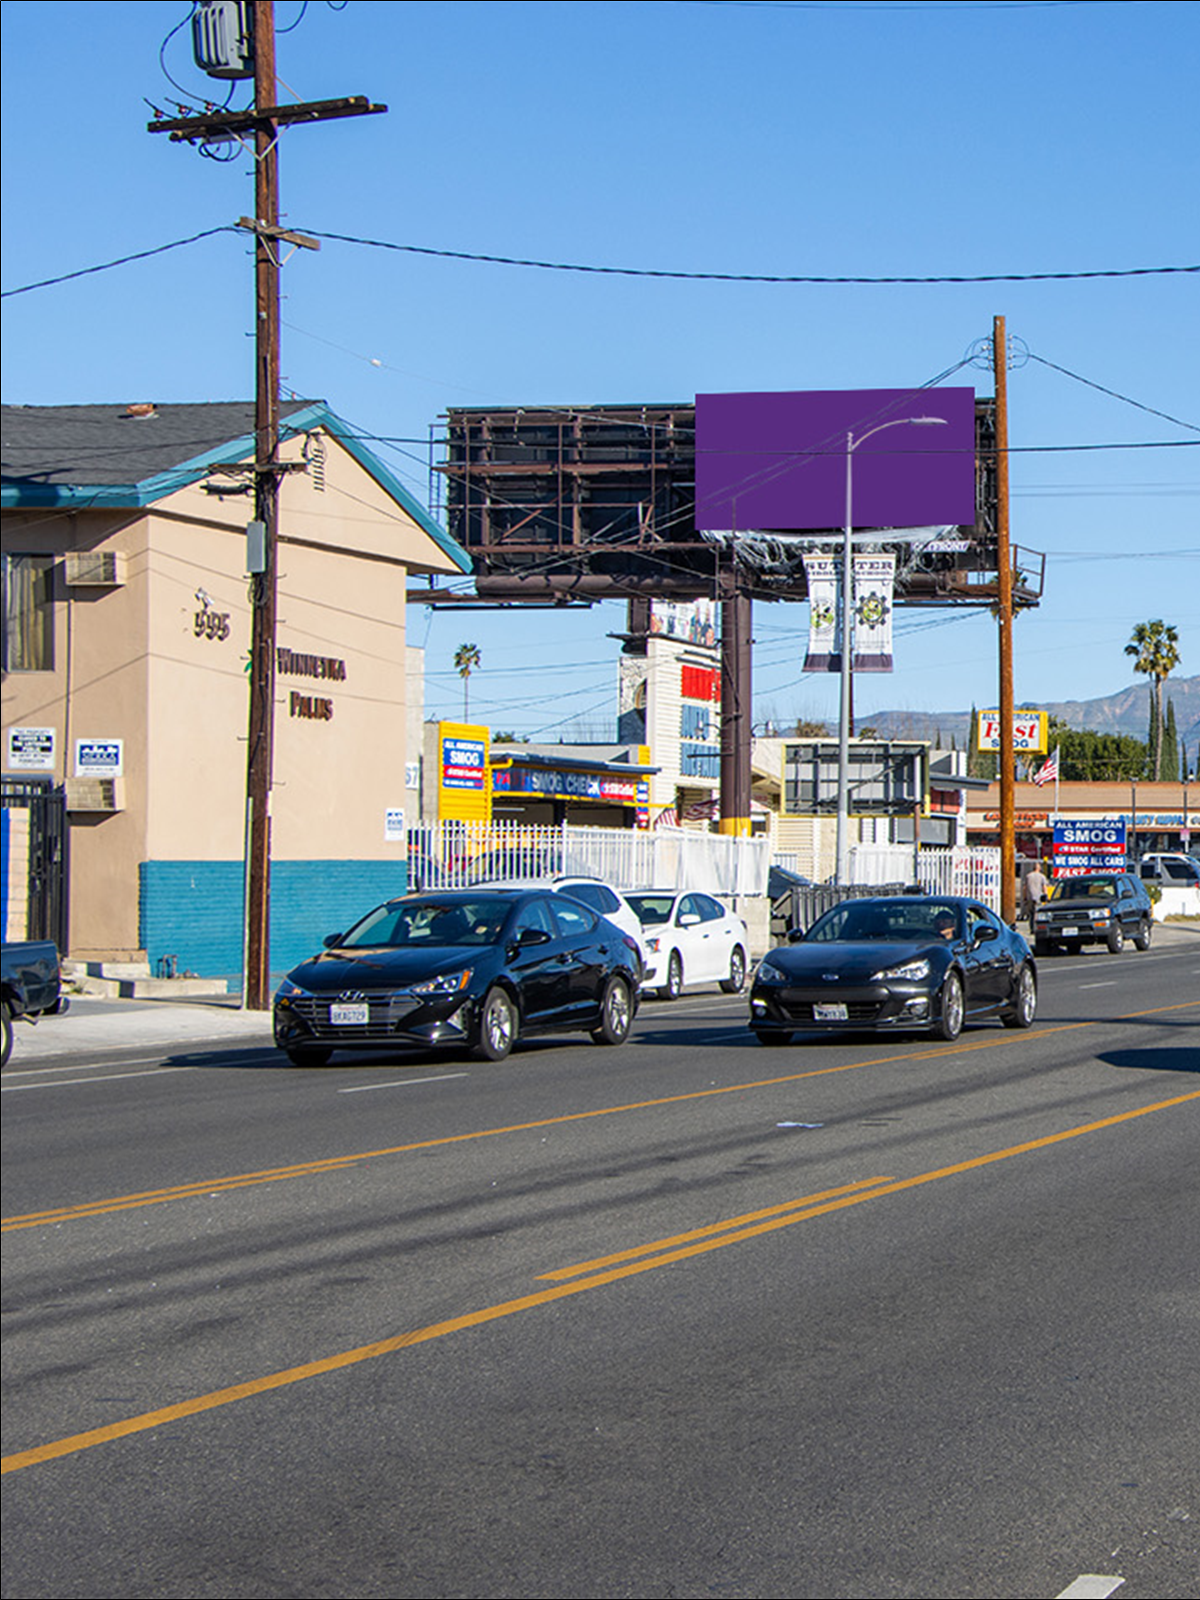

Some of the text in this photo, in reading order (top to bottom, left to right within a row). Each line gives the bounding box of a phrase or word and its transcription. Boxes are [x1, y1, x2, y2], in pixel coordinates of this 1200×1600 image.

[991, 739, 1029, 748] SOG
[450, 751, 480, 766] SMOG
[1056, 821, 1123, 829] ALL AMERICAN
[1063, 829, 1117, 842] SMOG
